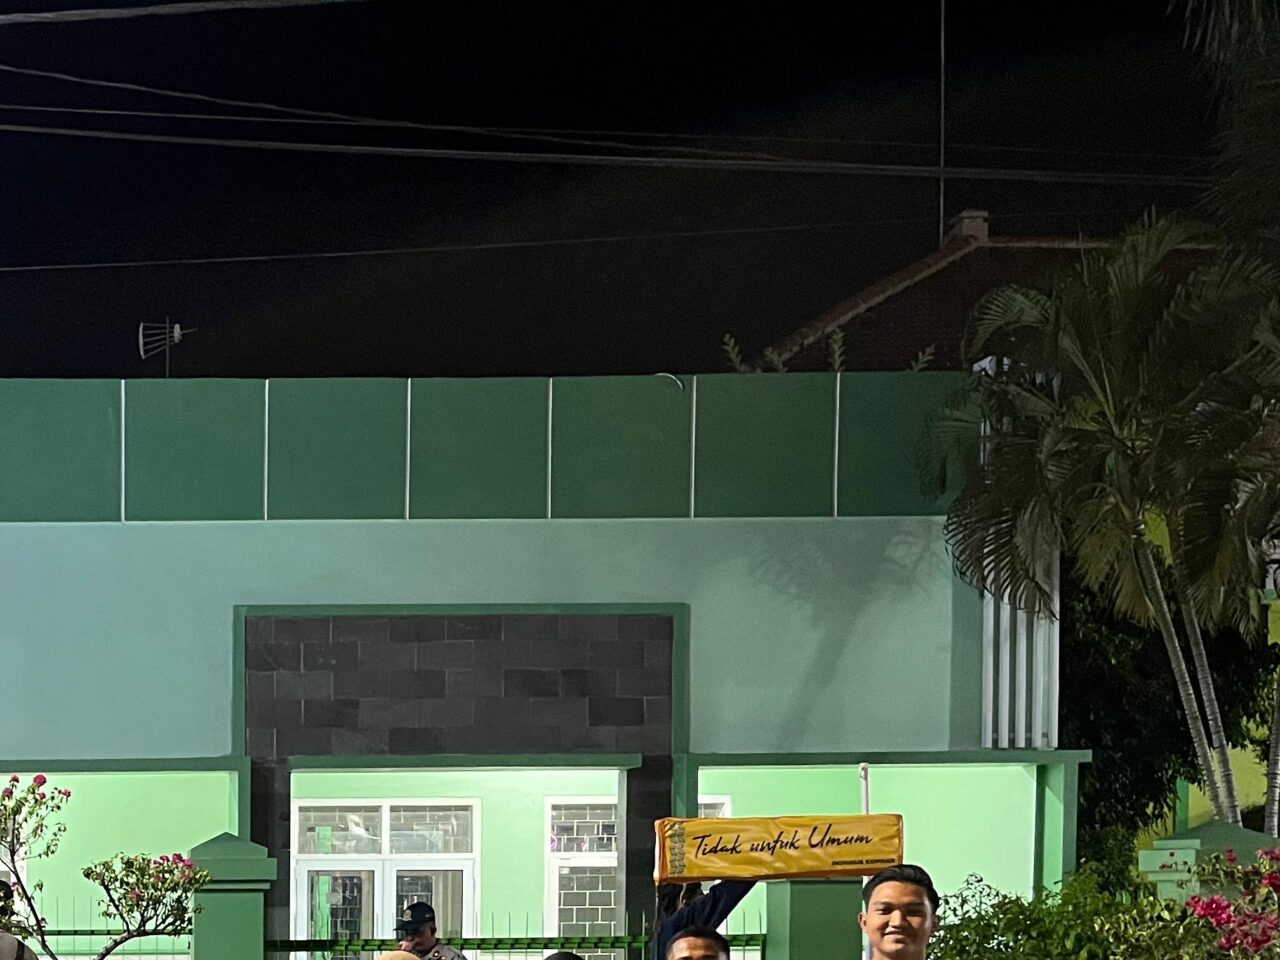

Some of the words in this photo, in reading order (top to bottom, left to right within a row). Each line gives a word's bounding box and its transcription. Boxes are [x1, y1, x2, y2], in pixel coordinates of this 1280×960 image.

[692, 834, 742, 858] Tidak
[750, 830, 800, 855] untuk
[808, 823, 872, 848] Umum
